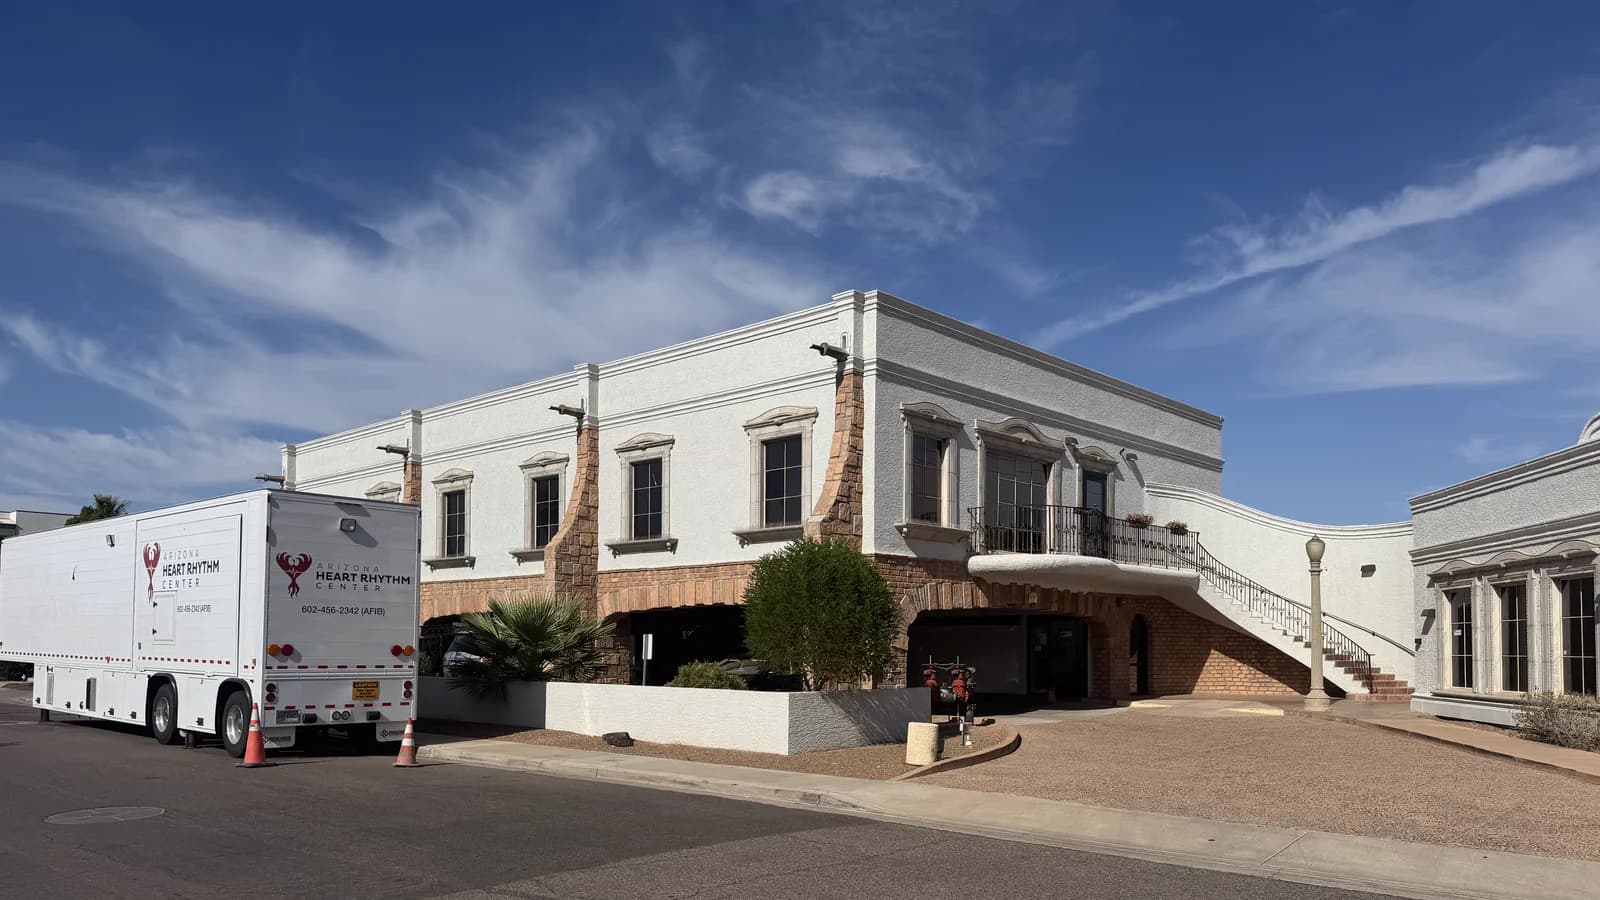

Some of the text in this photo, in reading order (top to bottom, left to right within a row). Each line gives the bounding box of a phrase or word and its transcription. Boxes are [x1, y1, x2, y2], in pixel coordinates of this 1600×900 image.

[163, 549, 200, 560] ARIZONA
[162, 560, 219, 577] HEART RHYTHM
[316, 562, 380, 573] ARIZONA
[162, 578, 200, 590] CENTER
[316, 571, 411, 585] HEART RHYTHM
[315, 582, 381, 592] CENTER
[301, 605, 386, 617] 602-456-2342 (AFIB)
